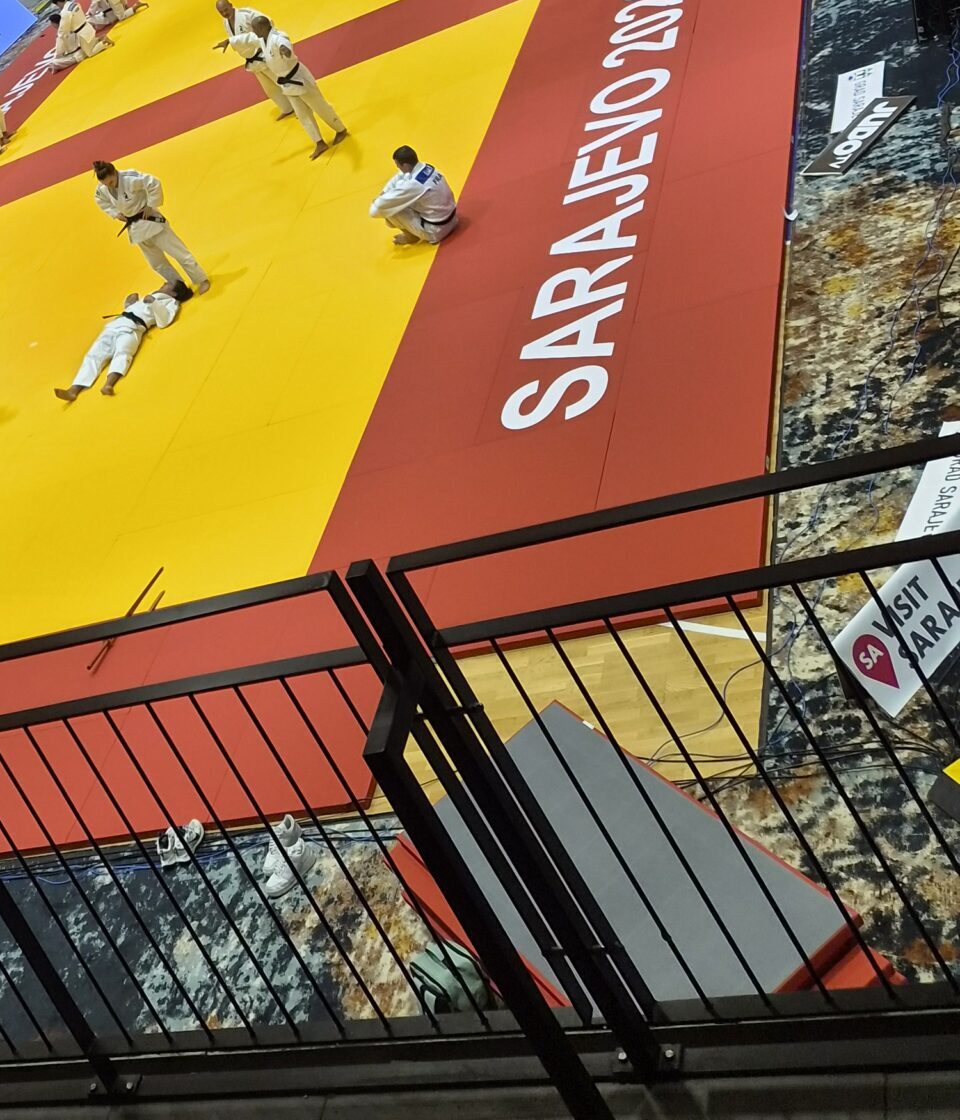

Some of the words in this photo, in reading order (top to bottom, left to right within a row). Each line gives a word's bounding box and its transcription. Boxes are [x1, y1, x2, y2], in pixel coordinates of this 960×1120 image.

[501, 68, 671, 430] SARAJEVO
[924, 486, 957, 533] SARAJE
[871, 575, 929, 638] VISIT
[859, 643, 884, 670] SA
